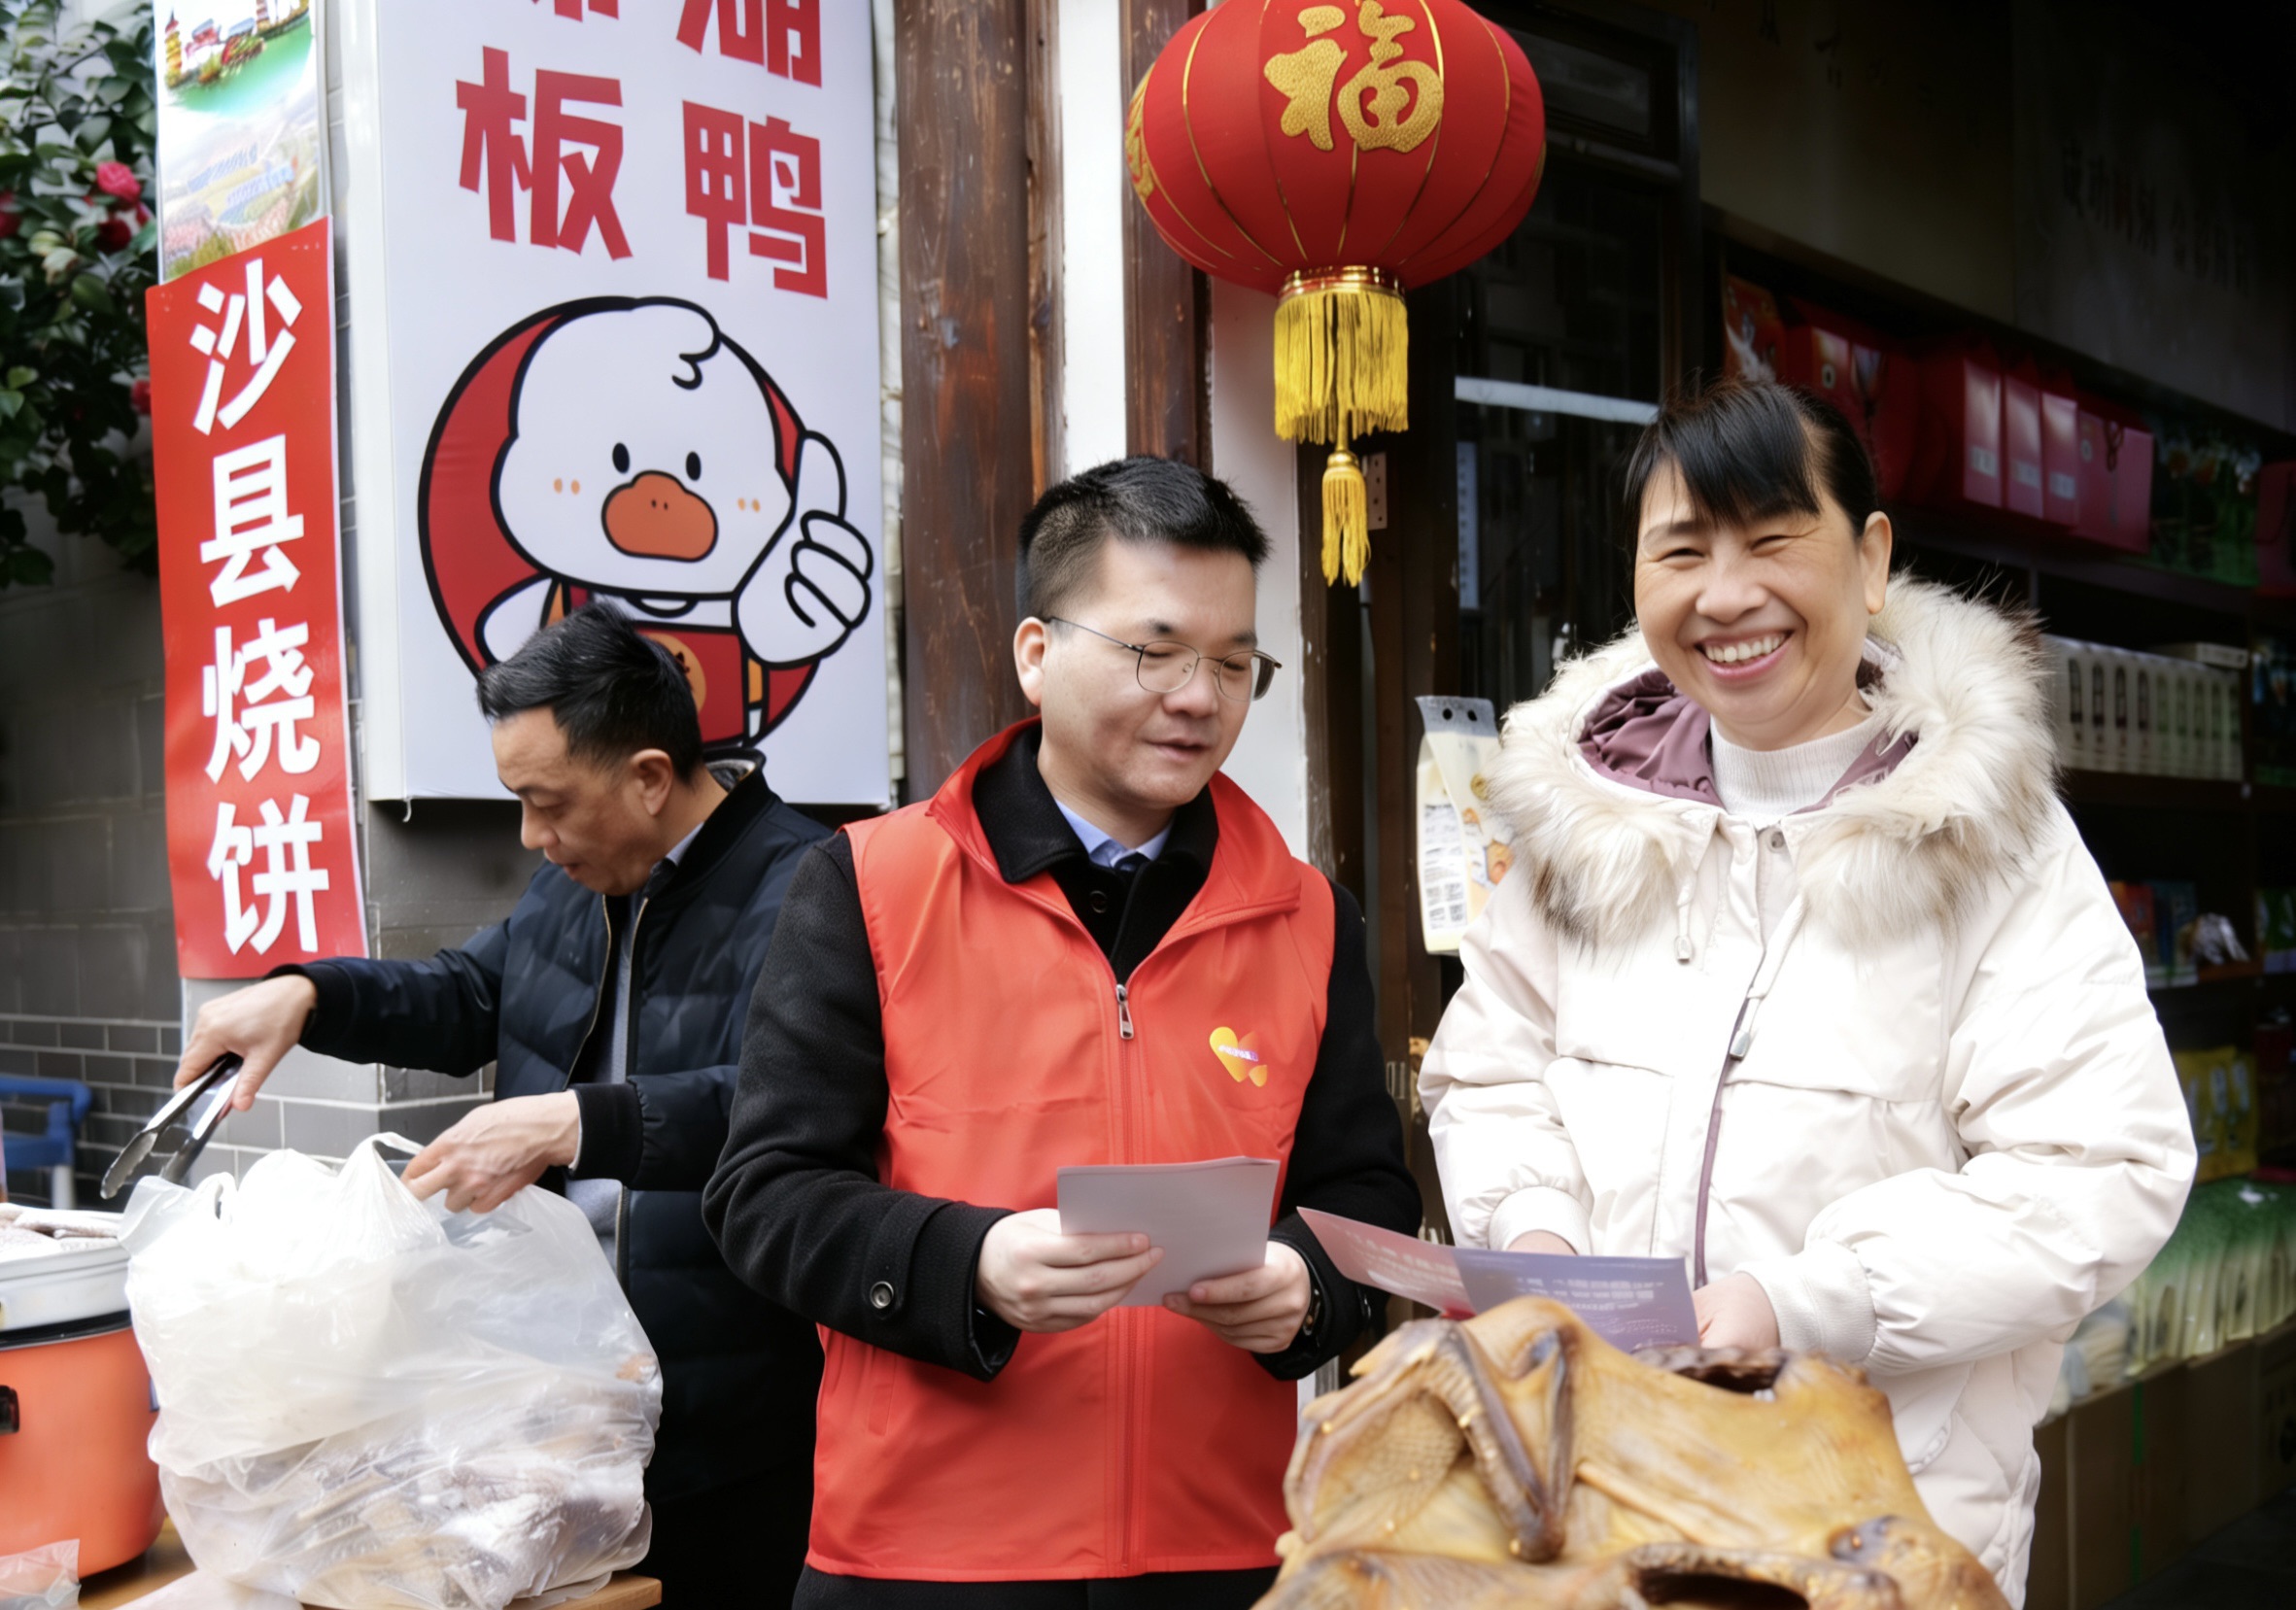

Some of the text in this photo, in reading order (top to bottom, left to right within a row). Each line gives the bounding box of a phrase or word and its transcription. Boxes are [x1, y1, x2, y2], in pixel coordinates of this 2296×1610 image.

[456, 45, 828, 300] 板鸭
[1264, 0, 1444, 154] 福
[189, 257, 329, 956] 沙县烧饼
